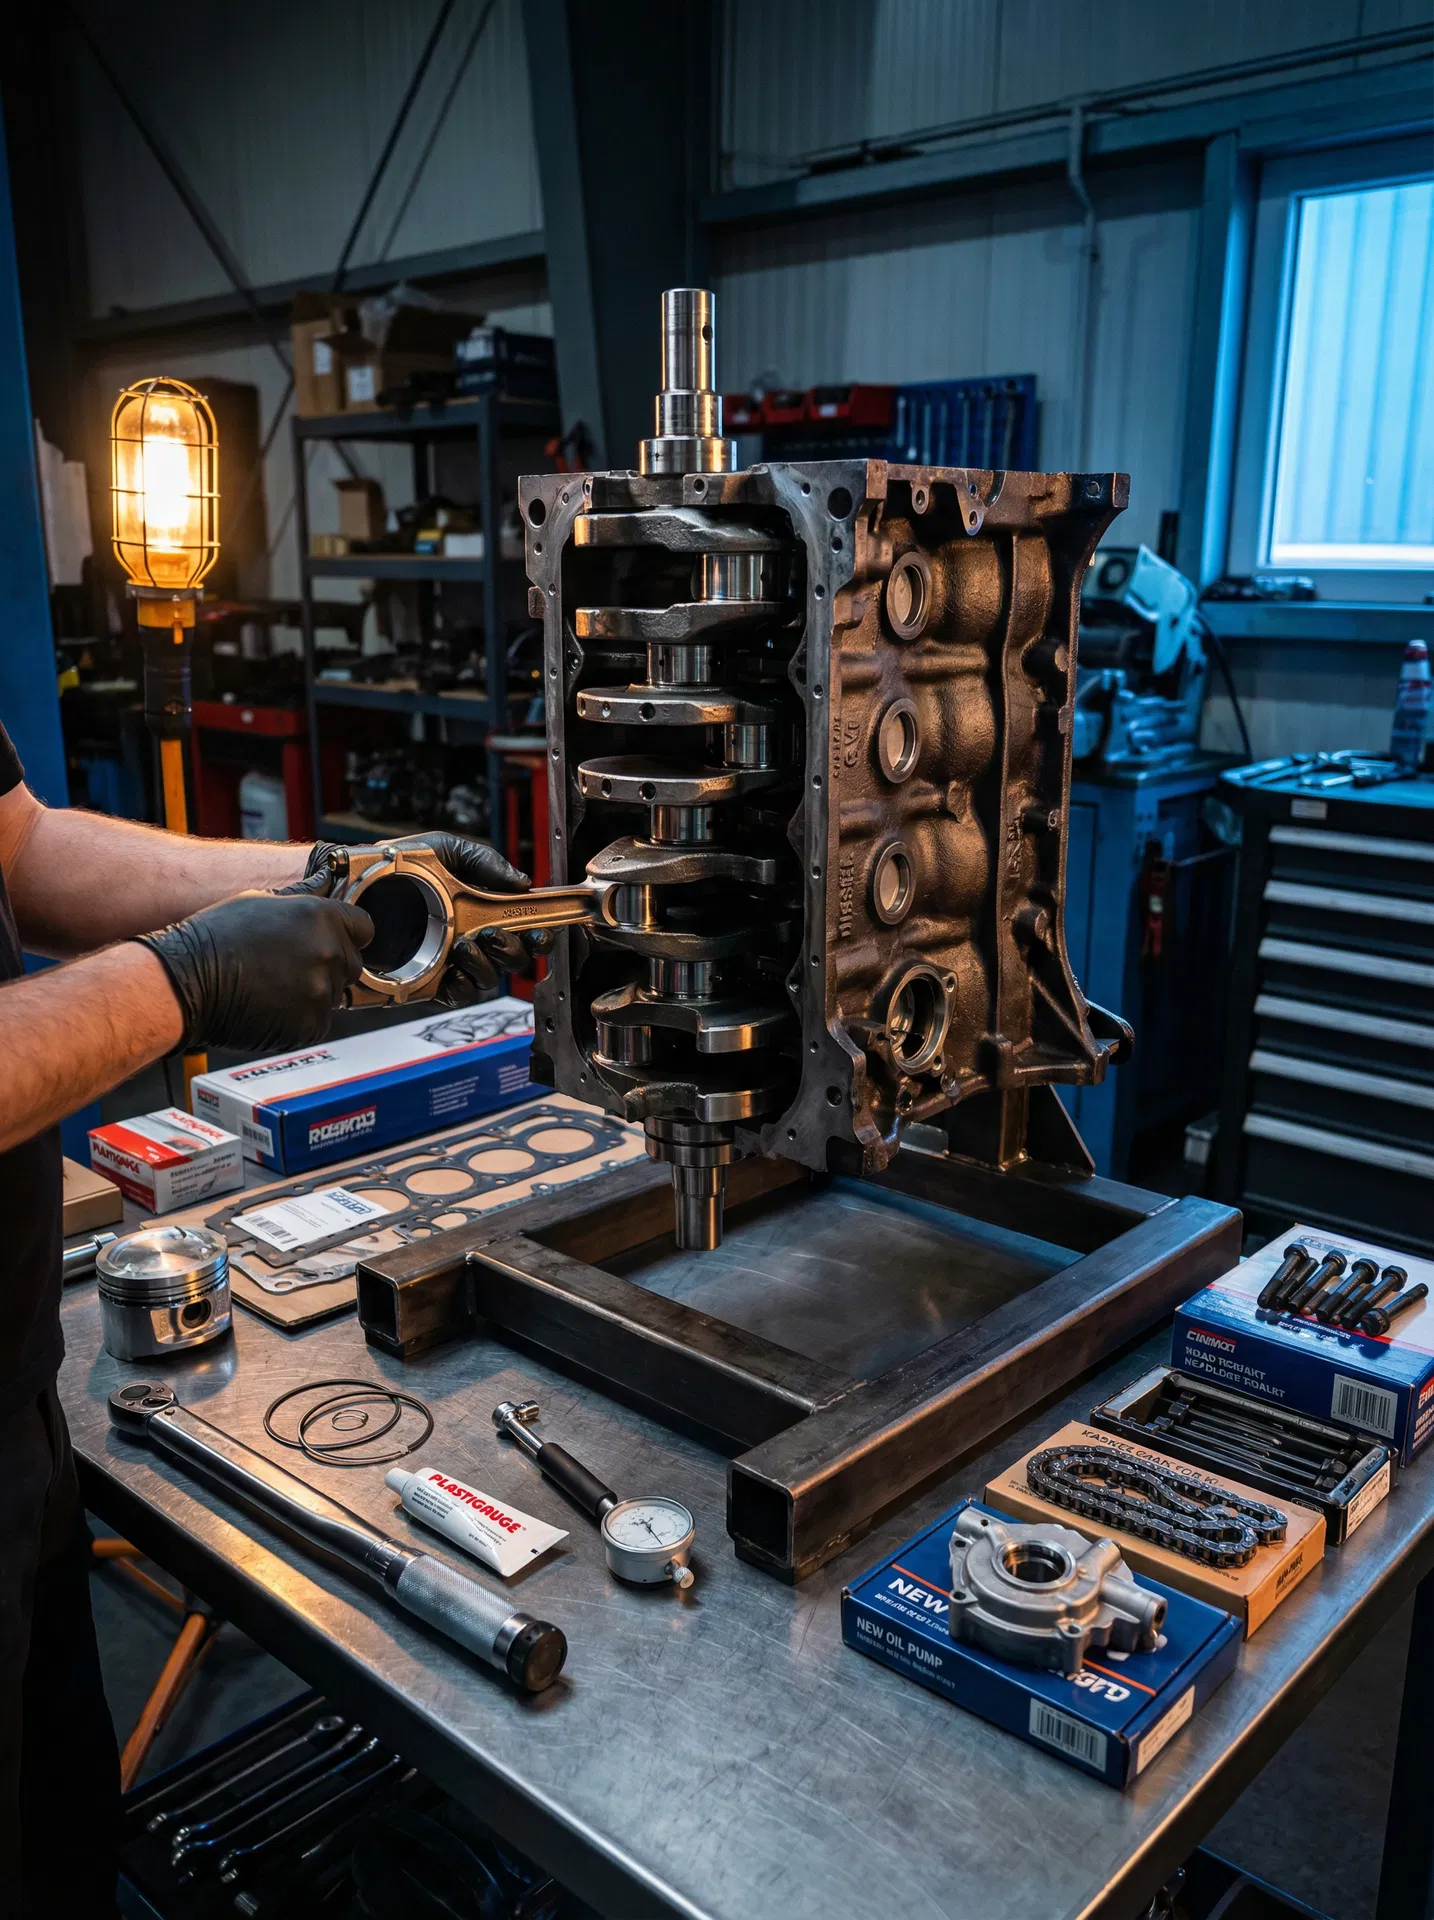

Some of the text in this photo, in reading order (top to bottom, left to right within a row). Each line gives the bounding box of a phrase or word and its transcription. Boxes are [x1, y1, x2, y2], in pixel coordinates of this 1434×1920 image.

[428, 1473, 521, 1534] PLASTIGAUGE
[887, 1577, 950, 1615] NEW
[856, 1616, 884, 1640] NEW
[886, 1631, 905, 1651] OIL
[907, 1642, 943, 1668] PUMP
